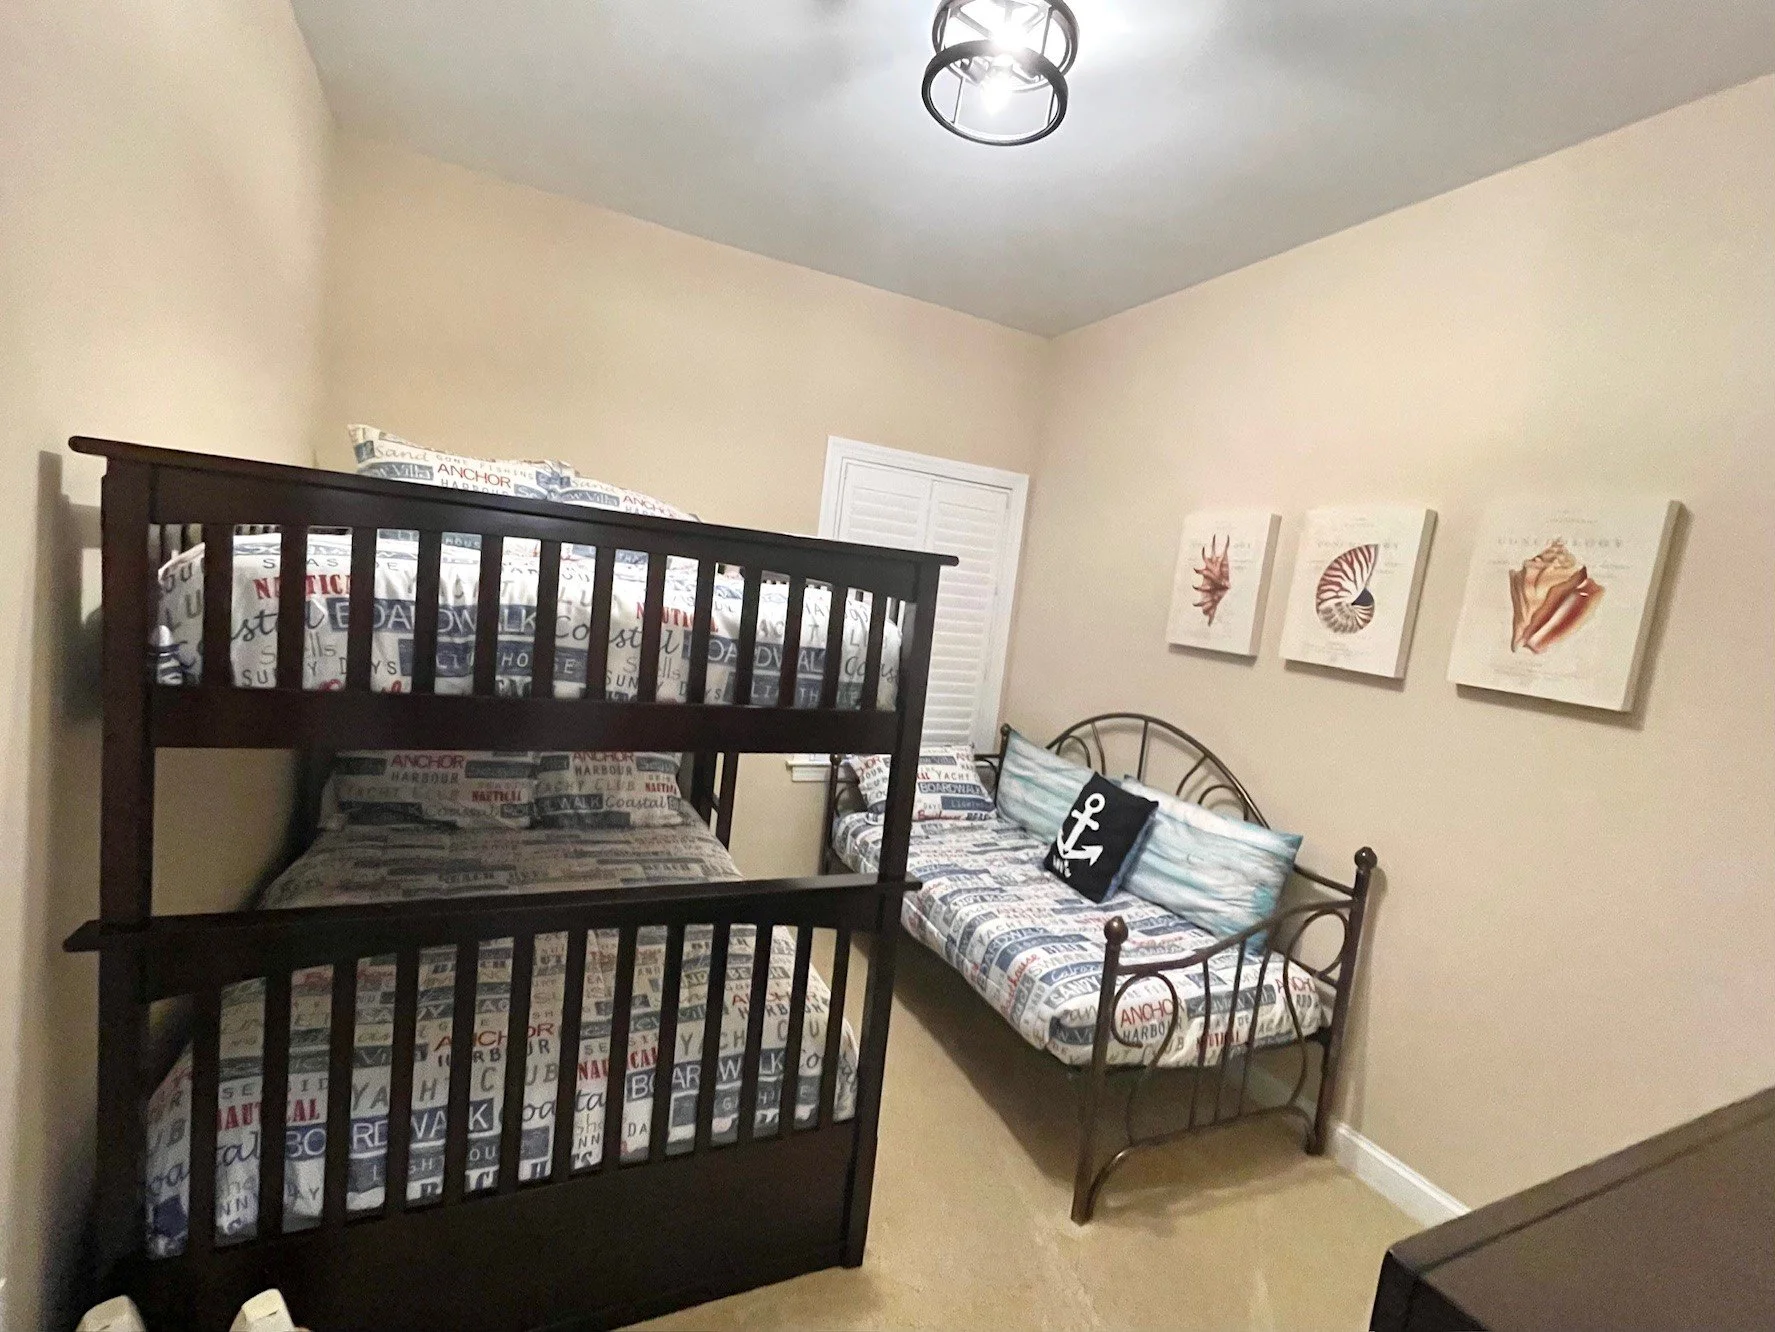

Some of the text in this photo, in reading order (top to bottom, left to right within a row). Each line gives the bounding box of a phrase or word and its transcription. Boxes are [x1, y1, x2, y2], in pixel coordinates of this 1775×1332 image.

[437, 463, 512, 489] ANCHOR
[391, 754, 465, 769] ANCHOR
[573, 752, 634, 762] ANCHOR
[575, 765, 635, 776] HARBOUR
[392, 771, 459, 784] HARBOUR
[606, 795, 666, 809] Coastal
